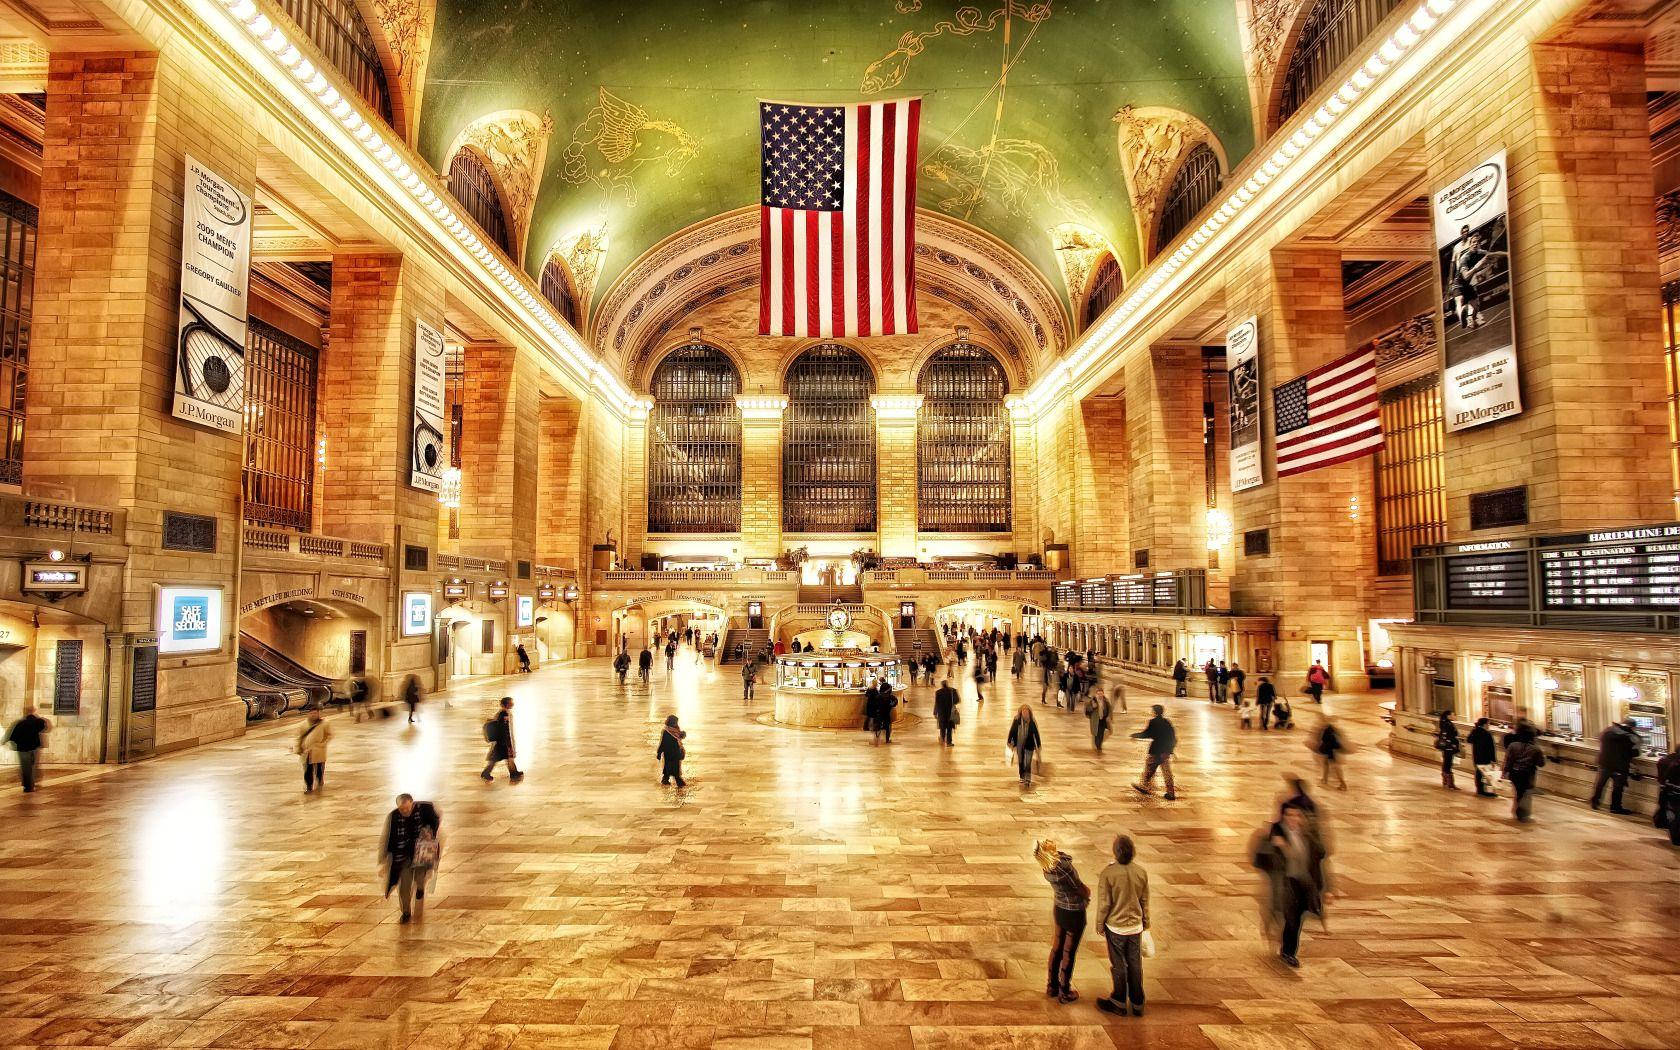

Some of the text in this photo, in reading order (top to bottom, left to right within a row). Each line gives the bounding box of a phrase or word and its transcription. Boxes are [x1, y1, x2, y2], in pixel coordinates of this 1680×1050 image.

[201, 172, 224, 192] Morgan
[196, 185, 229, 211] Champions
[200, 179, 235, 208] Tournament
[196, 221, 237, 250] 2009 MEN'S
[198, 233, 234, 259] CHAMPION
[186, 262, 241, 297] GREGORY GAULTIER
[179, 402, 235, 428] J.P.Morgan
[1589, 531, 1634, 541] HARLEM
[1636, 528, 1663, 538] LINE
[1458, 541, 1511, 552] INFORMATION
[1582, 547, 1636, 556] DESTINATION
[1645, 544, 1680, 552] REMAR
[254, 592, 283, 608] METLIFE
[284, 587, 313, 599] BUILDING
[346, 591, 365, 603] STREET
[181, 605, 202, 614] SAFE
[181, 613, 201, 622] AND
[175, 620, 207, 631] SECURE
